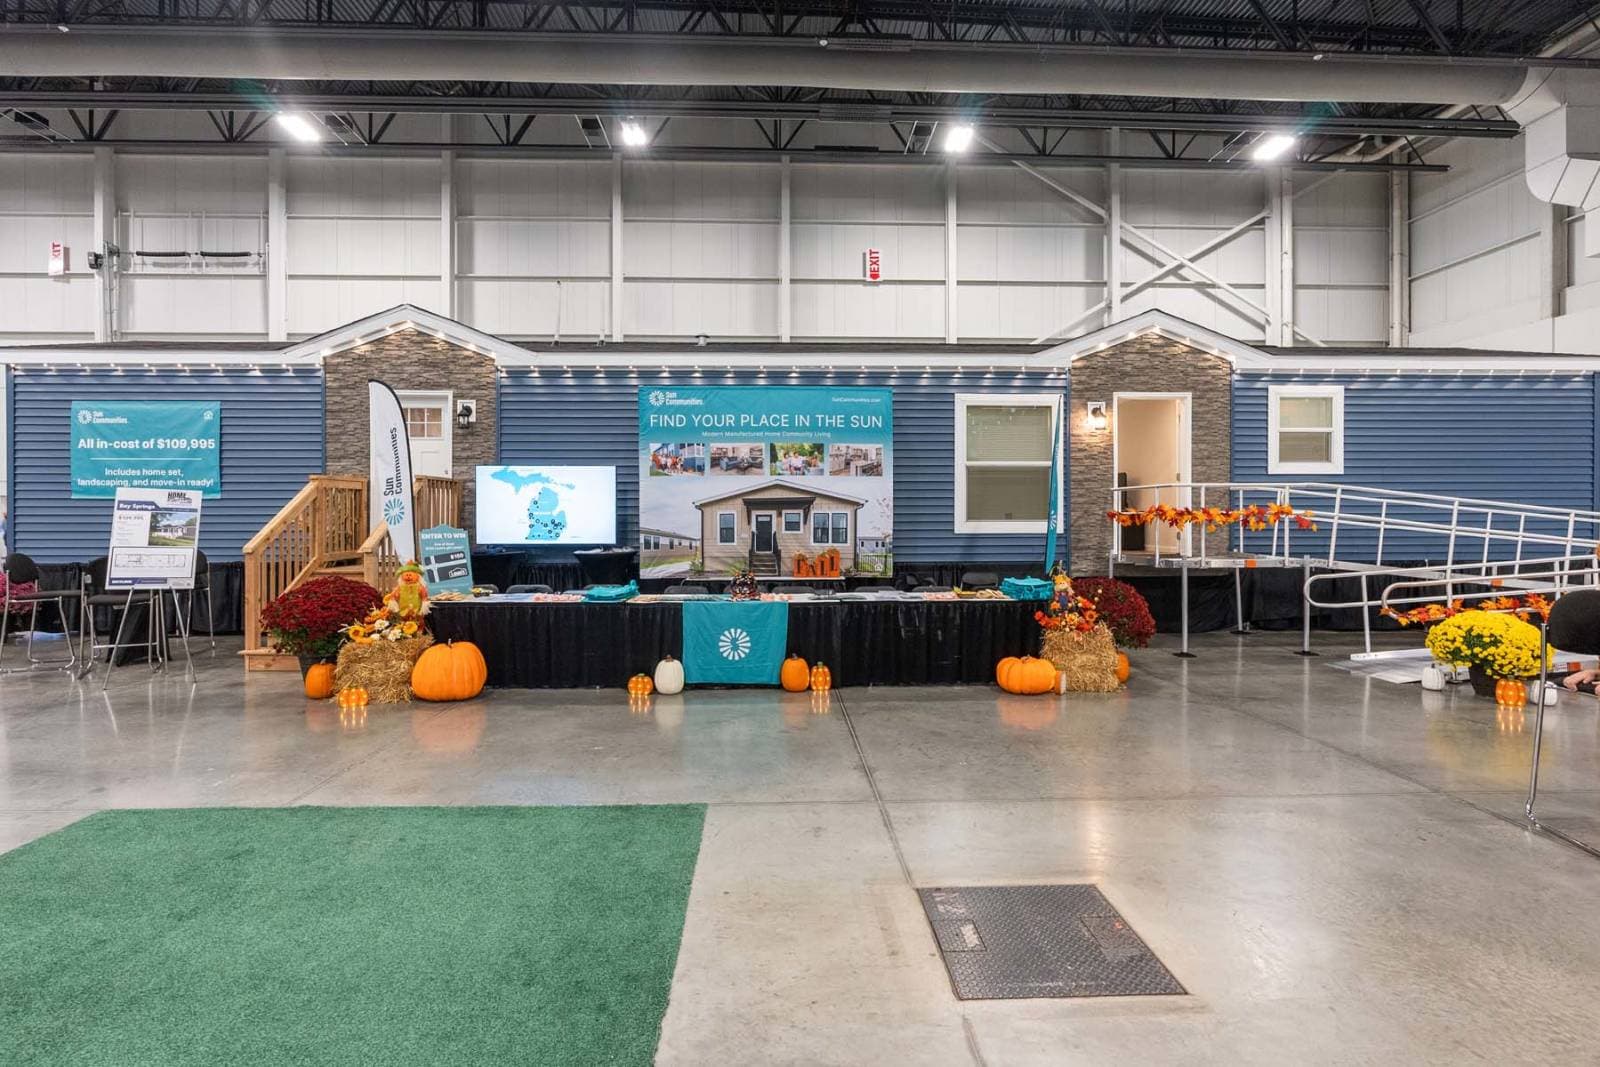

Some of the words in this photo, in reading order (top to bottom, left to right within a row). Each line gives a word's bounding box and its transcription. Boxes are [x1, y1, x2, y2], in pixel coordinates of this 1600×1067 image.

[869, 248, 880, 273] EXIT
[650, 414, 687, 427] FIND
[692, 414, 735, 428] YOUR
[740, 414, 789, 427] PLACE
[795, 414, 810, 427] IN
[815, 415, 845, 428] THE
[850, 415, 883, 428] SUN
[78, 438, 94, 449] All
[96, 438, 139, 449] in-cost
[142, 438, 156, 449] of
[157, 437, 216, 450] $109,995
[390, 427, 403, 495] Communities
[105, 468, 141, 476] Includes
[142, 468, 167, 476] home
[168, 469, 184, 478] set,
[77, 478, 130, 488] landscaping,
[132, 479, 149, 487] and
[150, 478, 186, 487] move-in
[187, 478, 214, 488] ready!
[383, 477, 395, 496] Sun
